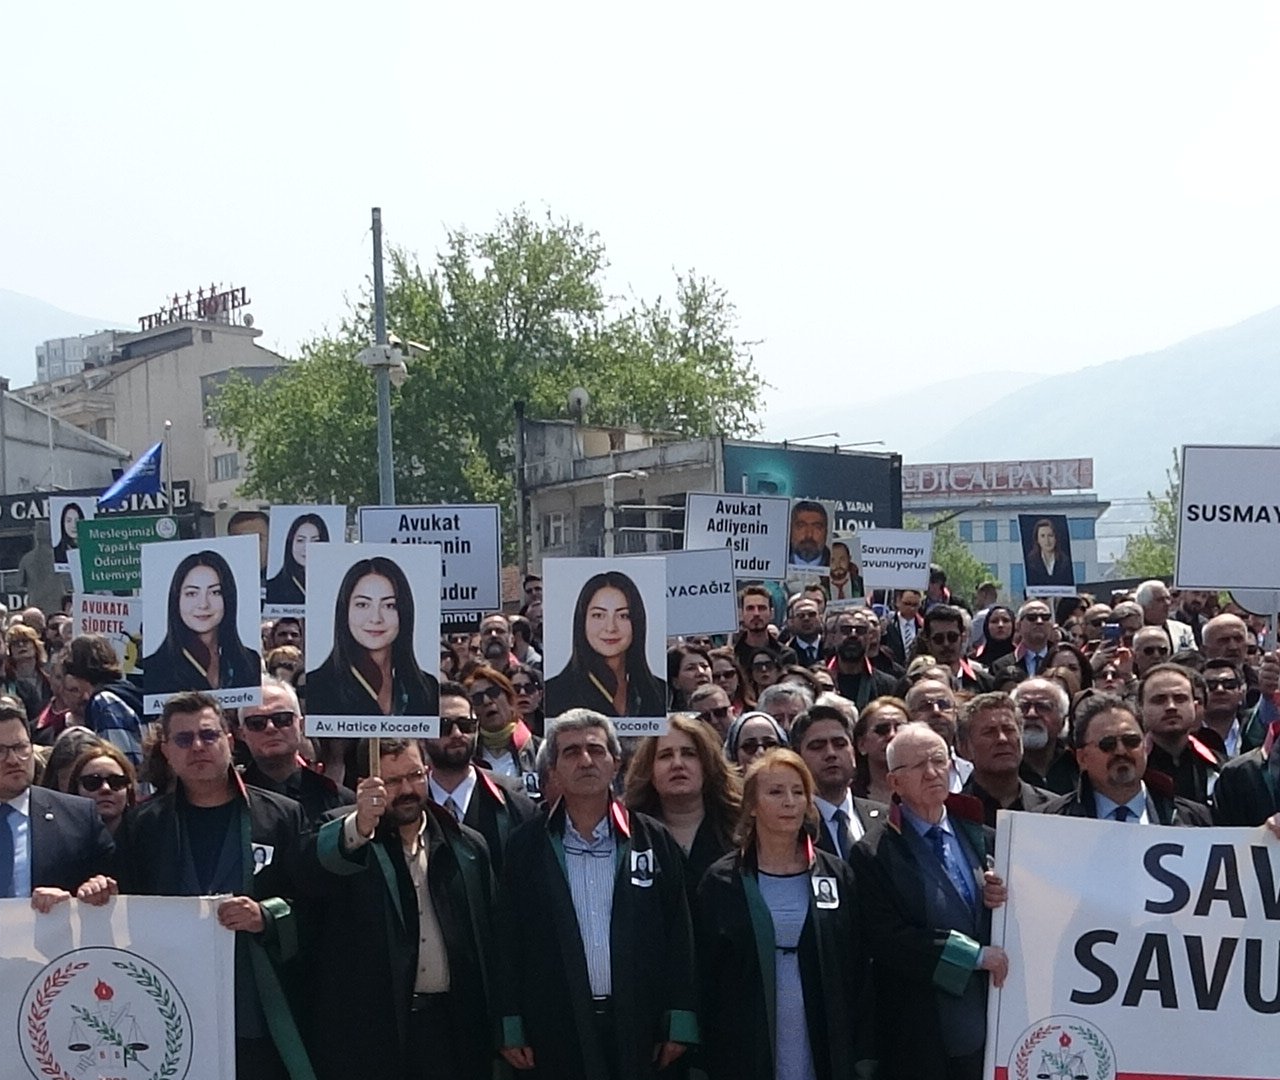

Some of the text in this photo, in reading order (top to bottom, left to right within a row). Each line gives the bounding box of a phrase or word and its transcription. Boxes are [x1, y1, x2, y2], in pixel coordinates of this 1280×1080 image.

[901, 463, 1081, 492] EDICALPARK
[715, 499, 762, 517] Avukat
[398, 513, 460, 532] Avukat
[707, 518, 768, 536] Adliyenin
[861, 545, 924, 557] Savunmayı
[735, 556, 771, 571] rudur
[861, 560, 927, 571] avunuyoruz
[666, 580, 731, 597] YACAĞIZ
[82, 600, 129, 616] AVUKATA
[218, 692, 254, 704] ocaefe
[316, 721, 431, 733] Av. Hatice Kocaefe
